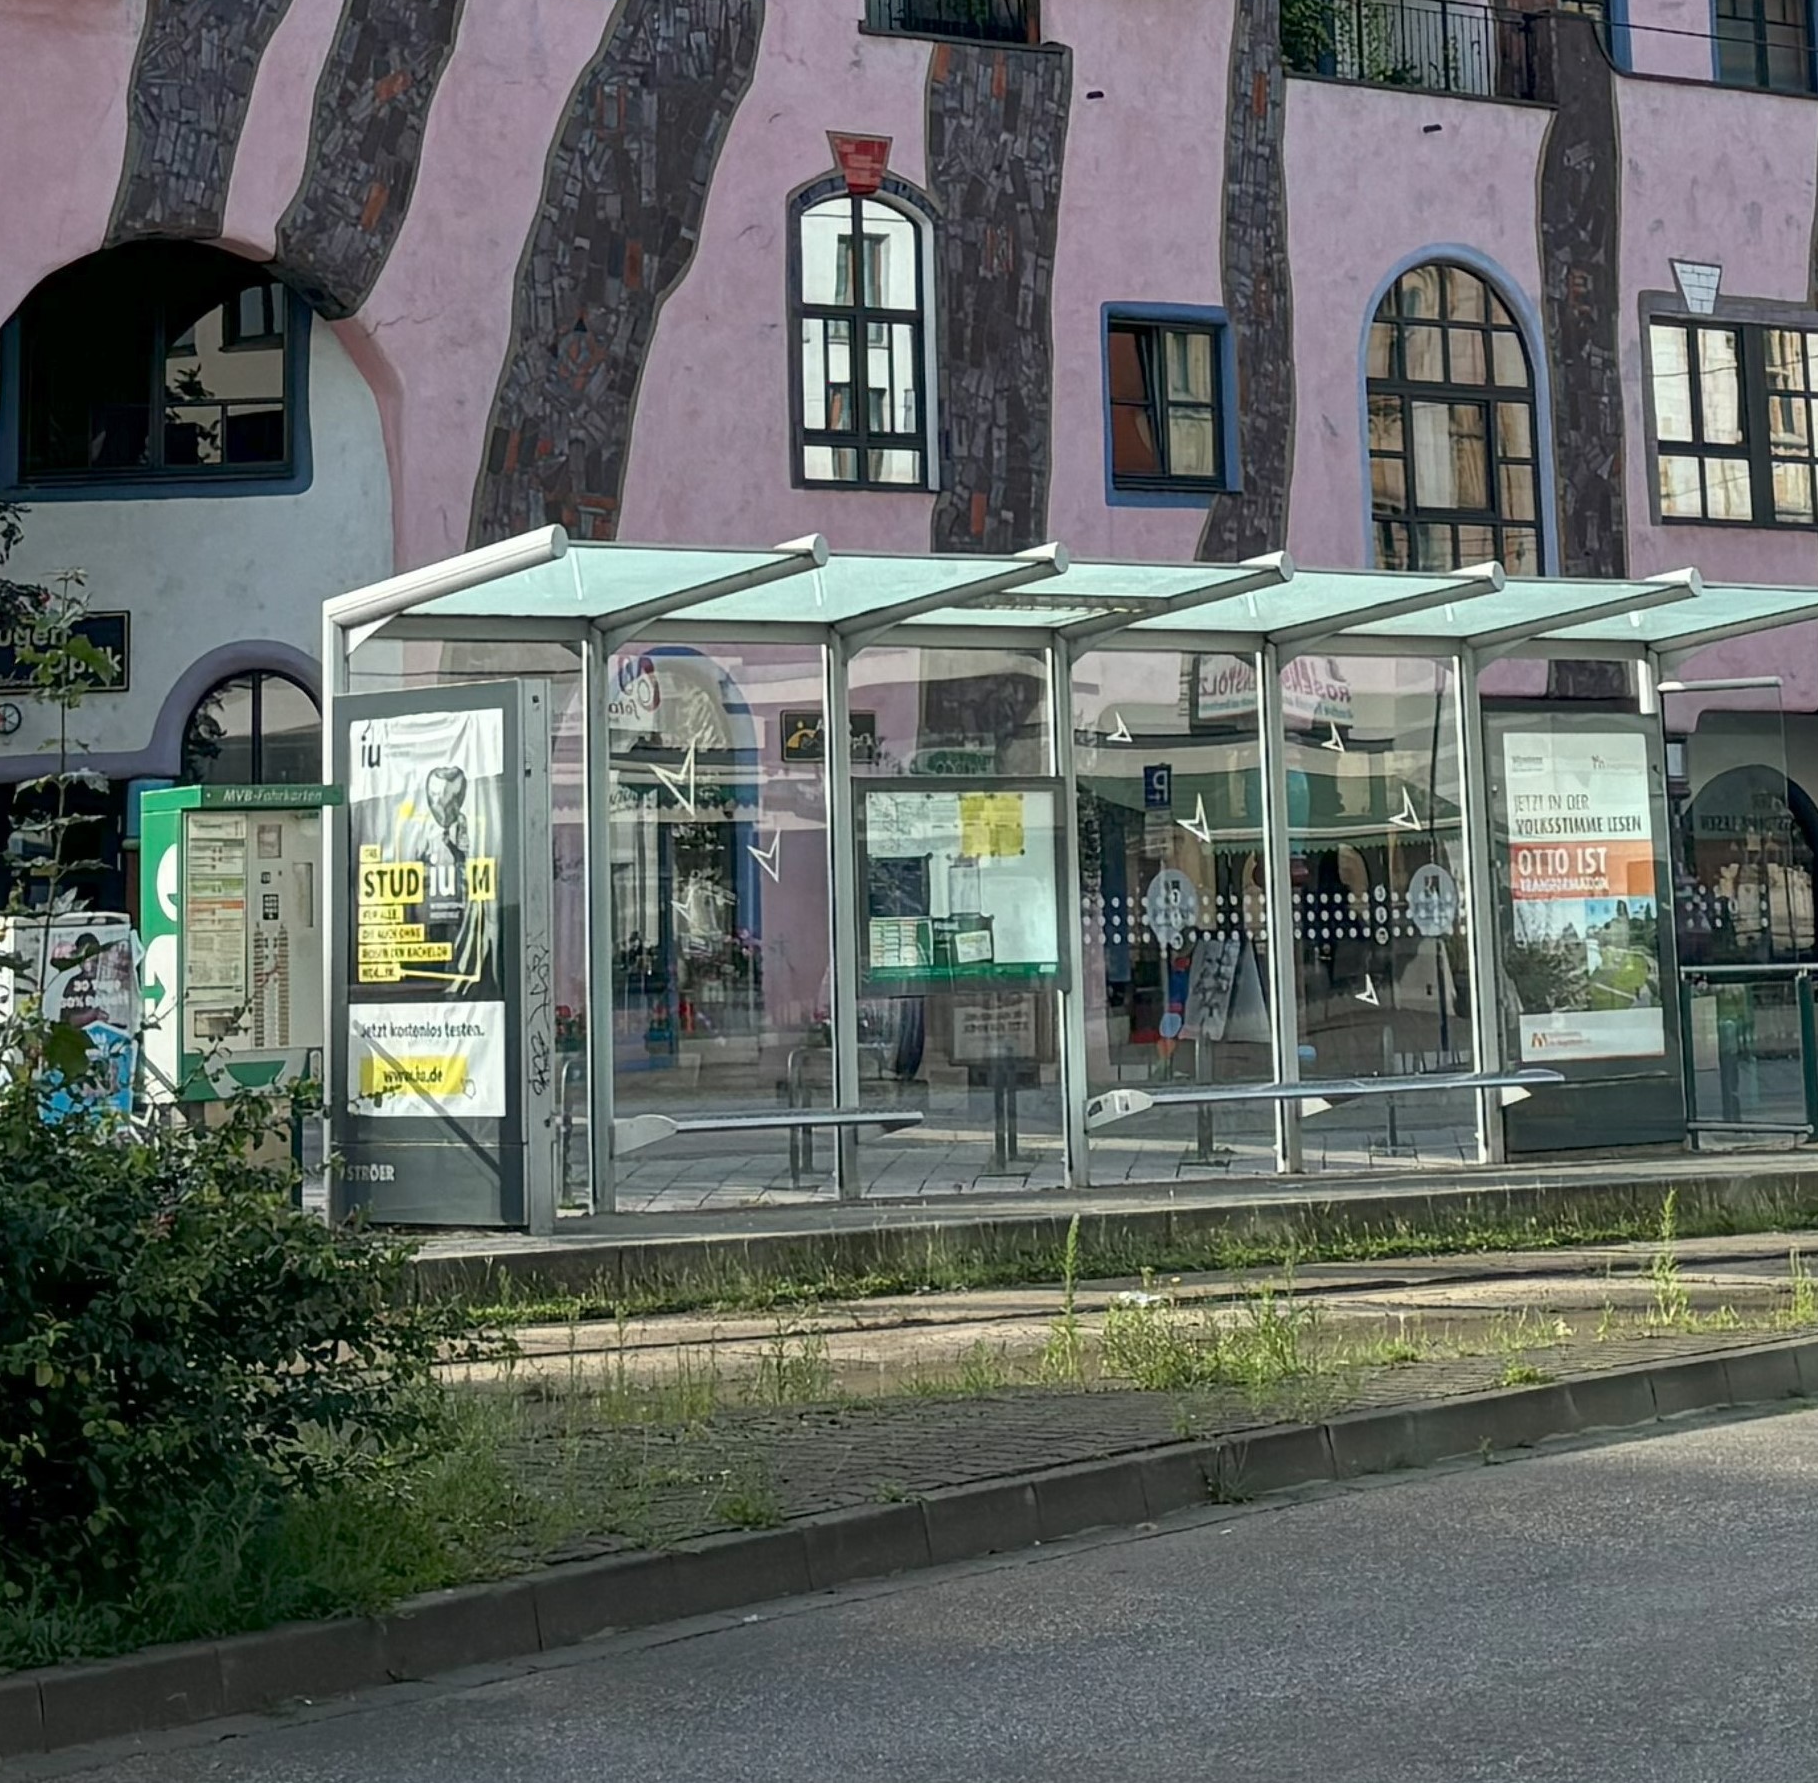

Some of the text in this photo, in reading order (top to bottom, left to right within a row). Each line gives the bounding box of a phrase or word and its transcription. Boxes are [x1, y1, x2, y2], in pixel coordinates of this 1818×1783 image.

[1567, 793, 1590, 811] DER
[1516, 815, 1642, 835] VOLKSSTIMME LESEN
[1517, 847, 1608, 876] OTTO IST
[390, 1021, 443, 1038] kostenlos
[346, 1163, 395, 1182] STRÖER
